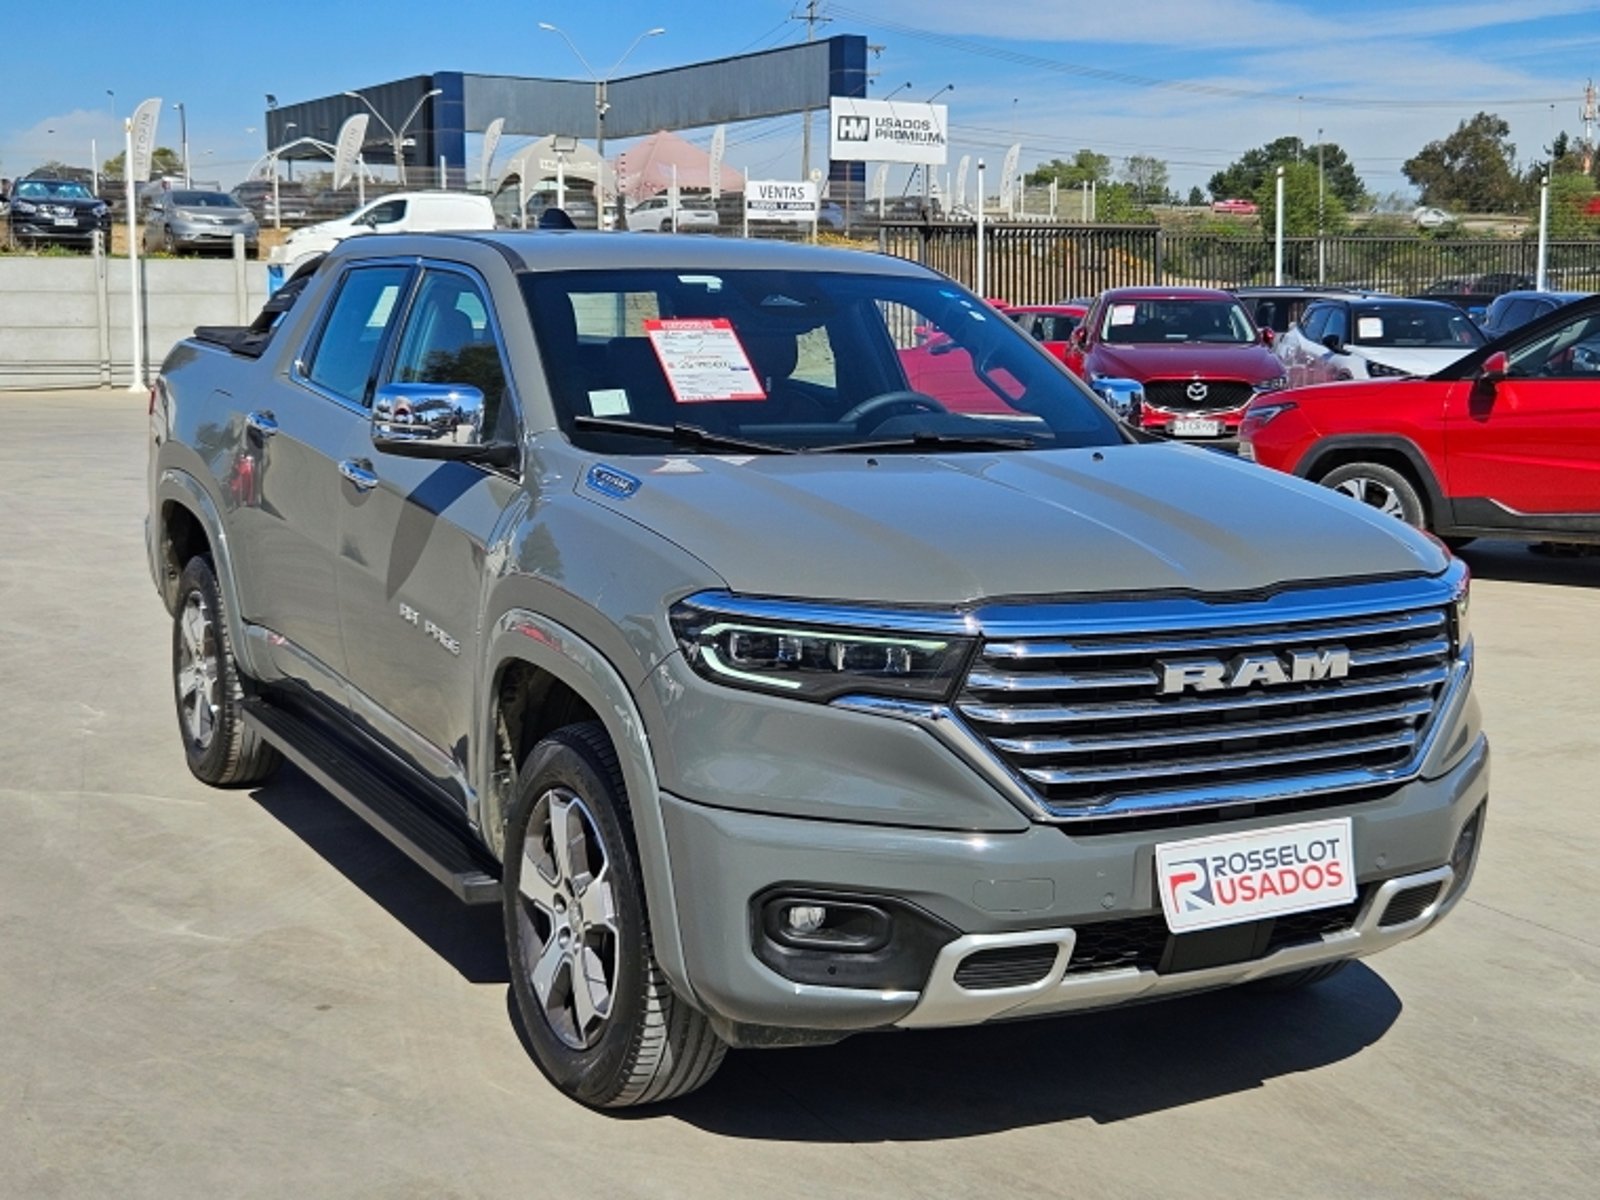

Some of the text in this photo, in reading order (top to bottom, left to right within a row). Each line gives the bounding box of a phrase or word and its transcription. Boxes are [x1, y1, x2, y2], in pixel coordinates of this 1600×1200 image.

[875, 118, 931, 131] USADOS
[759, 185, 805, 200] VENTAS
[1157, 645, 1350, 694] RAM
[1212, 838, 1340, 877] ROSSELOT
[1215, 862, 1344, 904] USADOS
